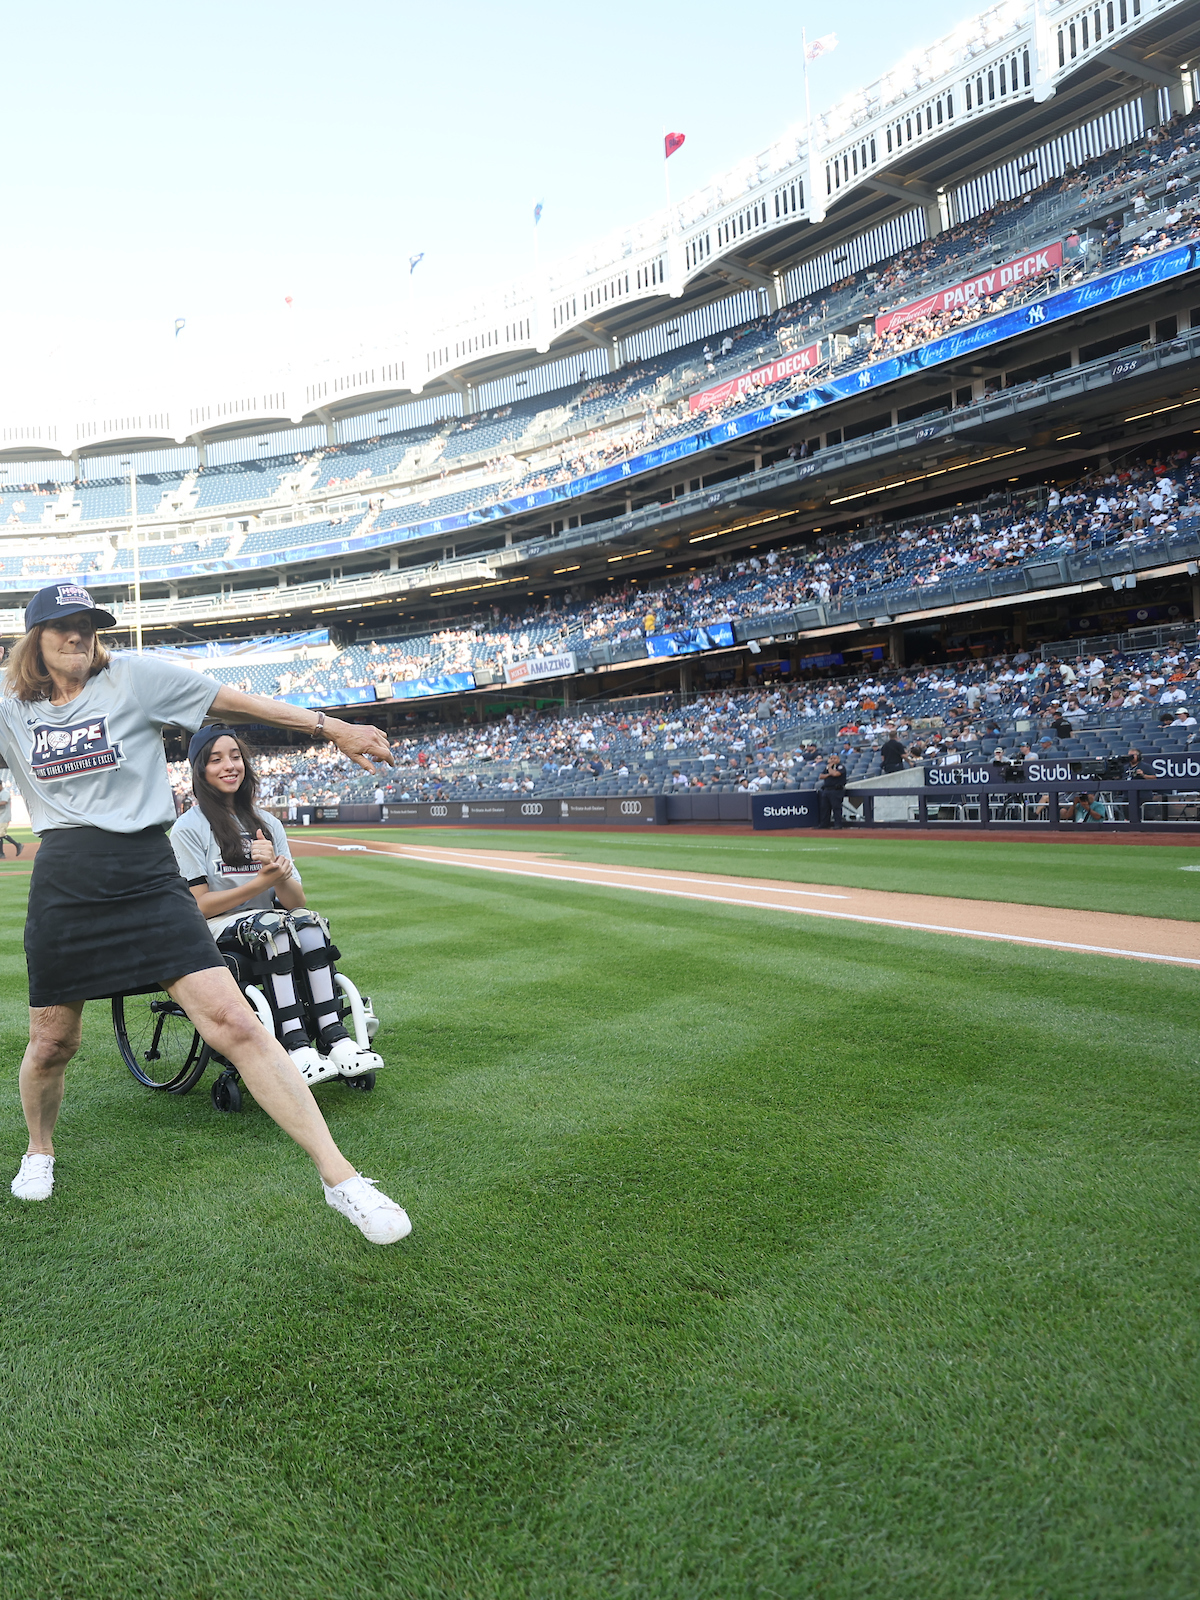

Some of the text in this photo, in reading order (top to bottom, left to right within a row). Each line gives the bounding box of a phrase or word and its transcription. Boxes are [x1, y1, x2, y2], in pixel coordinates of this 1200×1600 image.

[944, 273, 997, 309] PARTY
[1001, 251, 1049, 287] DECK
[1108, 269, 1147, 297] York
[950, 326, 997, 358] Yankees
[737, 366, 774, 392] PARTY
[777, 351, 811, 378] DECK
[530, 657, 571, 675] AMAZING
[35, 722, 103, 754] HOPE
[42, 742, 94, 759] WEEK
[46, 764, 64, 776] OTHERS
[64, 758, 92, 771] PERSEVERE
[97, 754, 114, 765] EXCEL
[1152, 758, 1200, 778] Stub
[763, 805, 809, 817] StubHub
